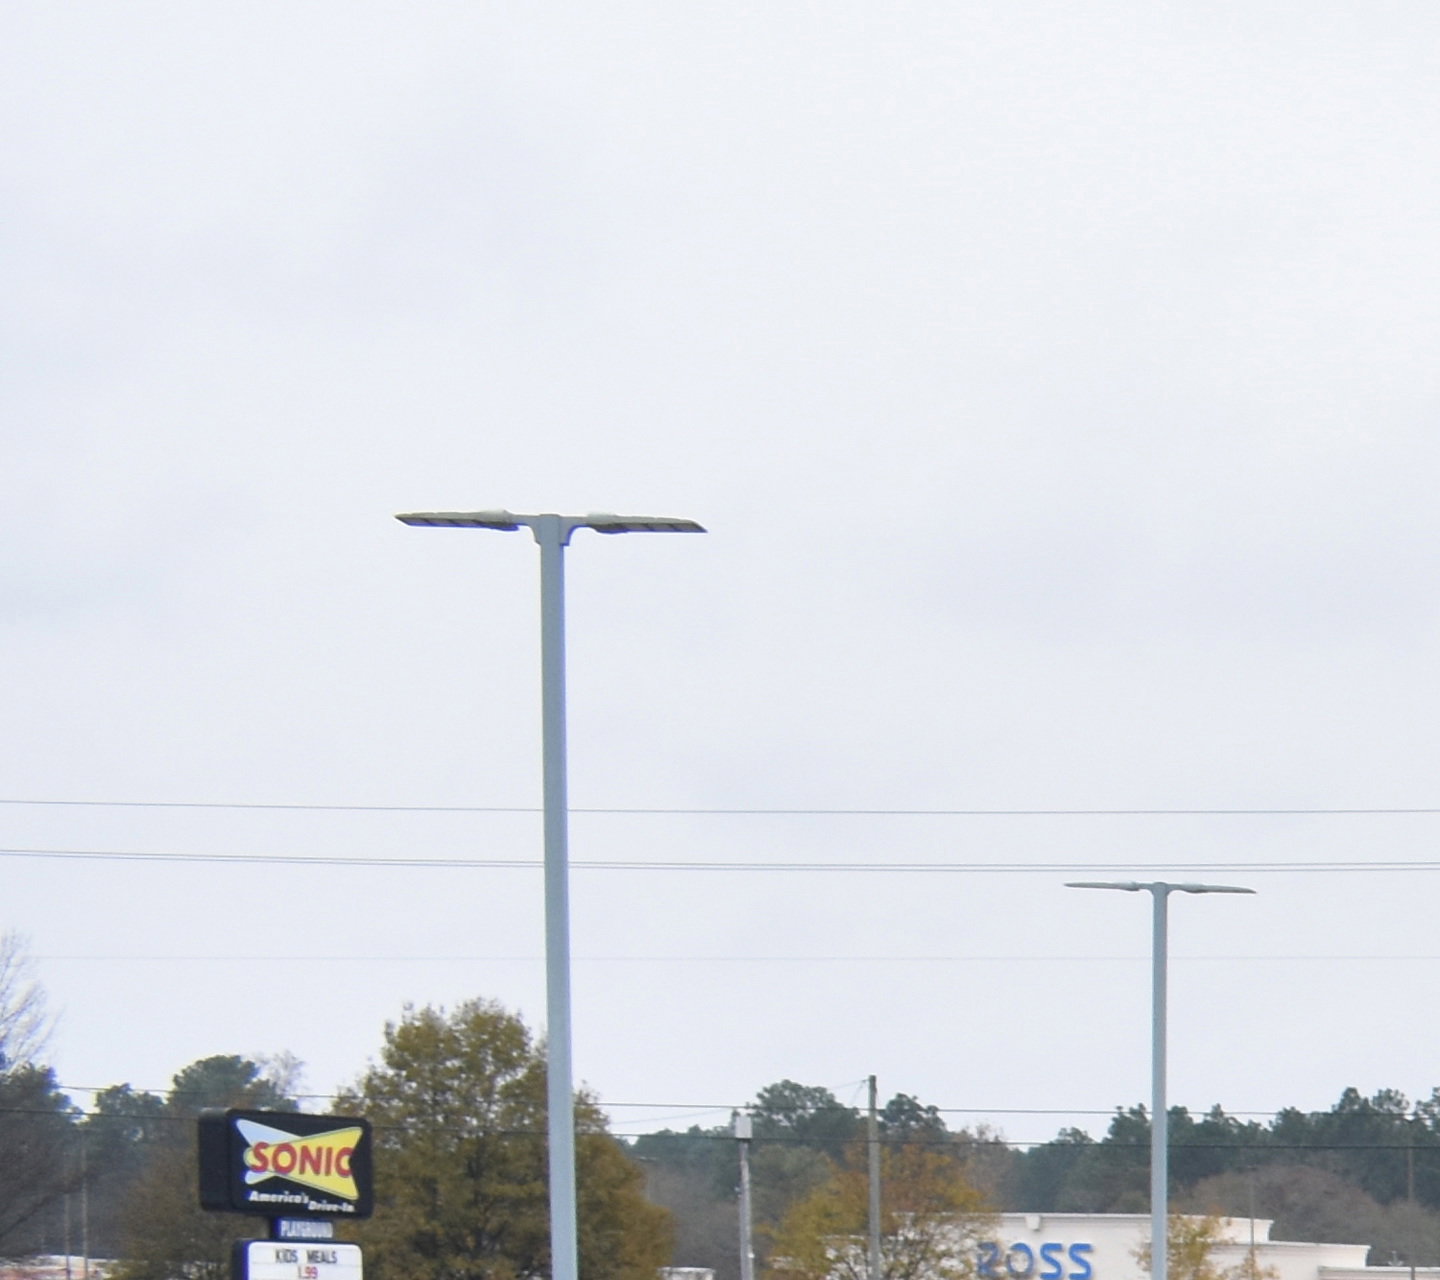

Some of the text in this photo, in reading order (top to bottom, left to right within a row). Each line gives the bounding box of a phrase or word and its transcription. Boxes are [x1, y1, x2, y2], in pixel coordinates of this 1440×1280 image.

[250, 1142, 355, 1178] SONIC
[249, 1190, 310, 1204] America's
[275, 1249, 338, 1264] KIDS MEALS
